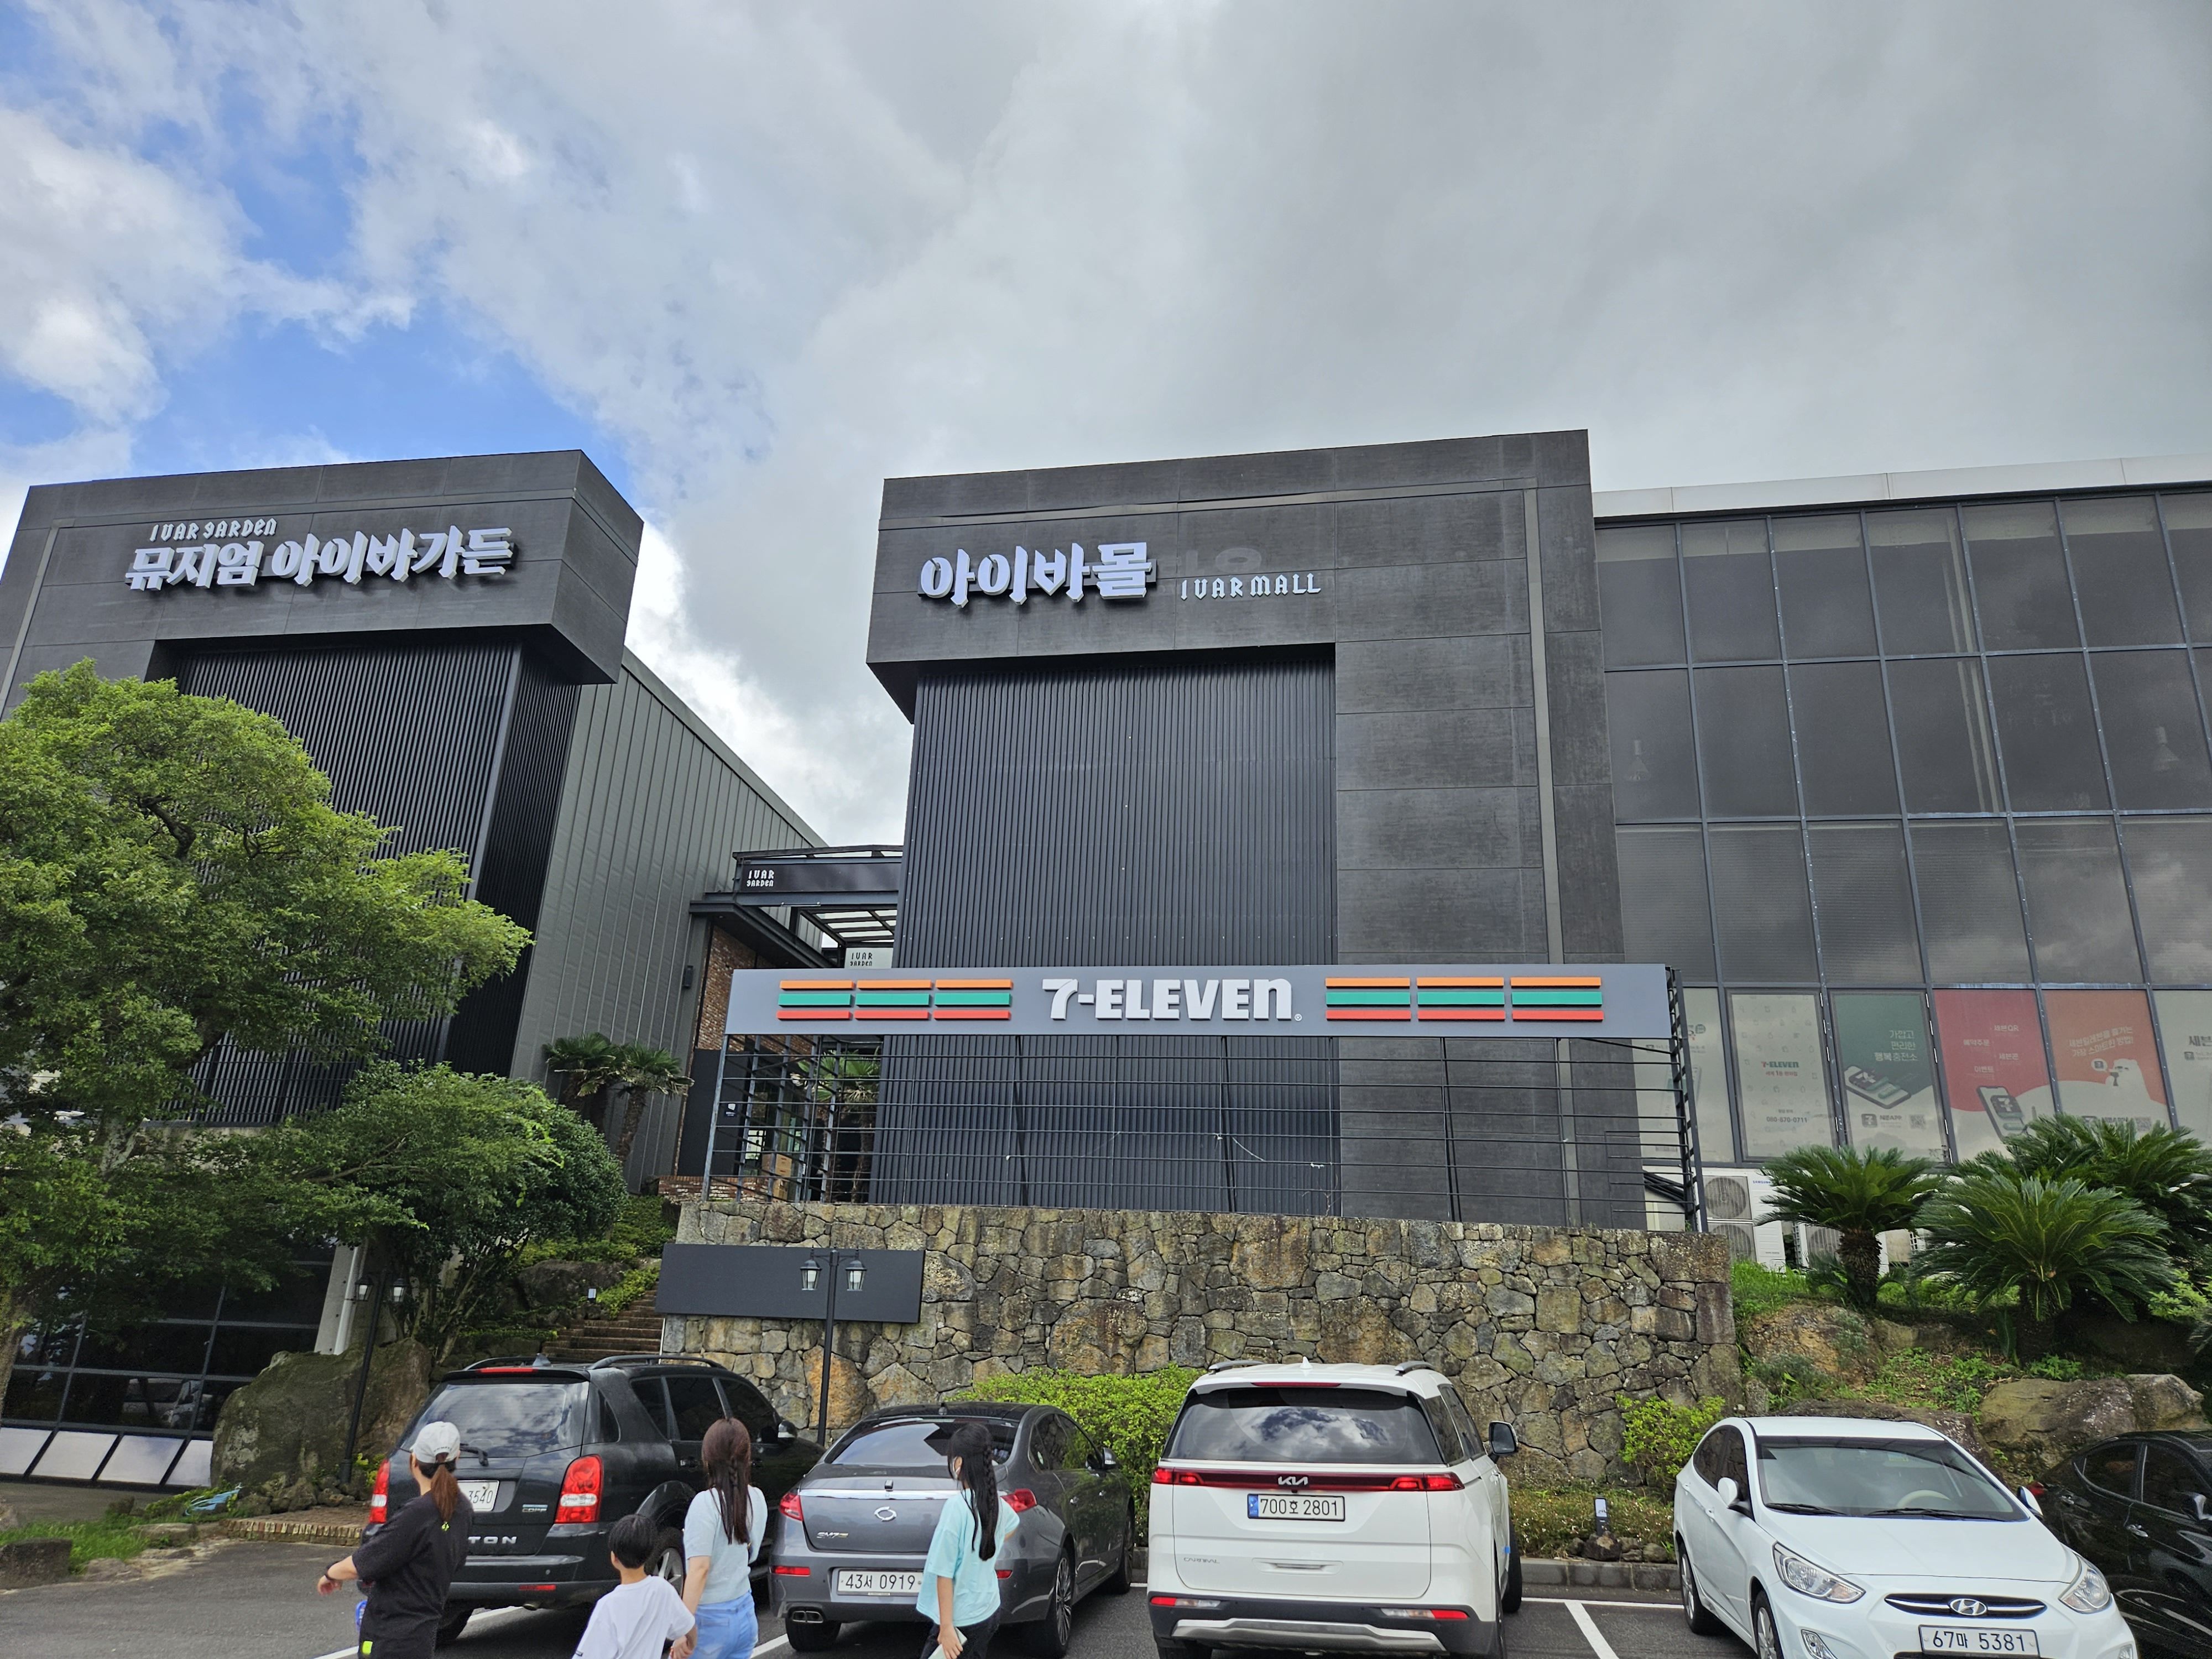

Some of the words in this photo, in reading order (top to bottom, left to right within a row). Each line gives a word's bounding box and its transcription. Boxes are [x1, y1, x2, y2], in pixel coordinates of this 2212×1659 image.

[125, 541, 264, 591] 뮤지엄
[272, 525, 513, 587] 아이바가든
[920, 542, 1152, 608] 아이바몰
[1181, 578, 1243, 600] IVAR
[1250, 573, 1321, 597] MALL
[748, 869, 775, 879] IVAR
[1260, 1499, 1299, 1514] 700호
[1303, 1500, 1337, 1516] 2801
[846, 1574, 873, 1589] 43서
[879, 1574, 916, 1590] 0919
[1933, 1630, 1968, 1648] 67마
[1979, 1632, 2025, 1652] 5381
